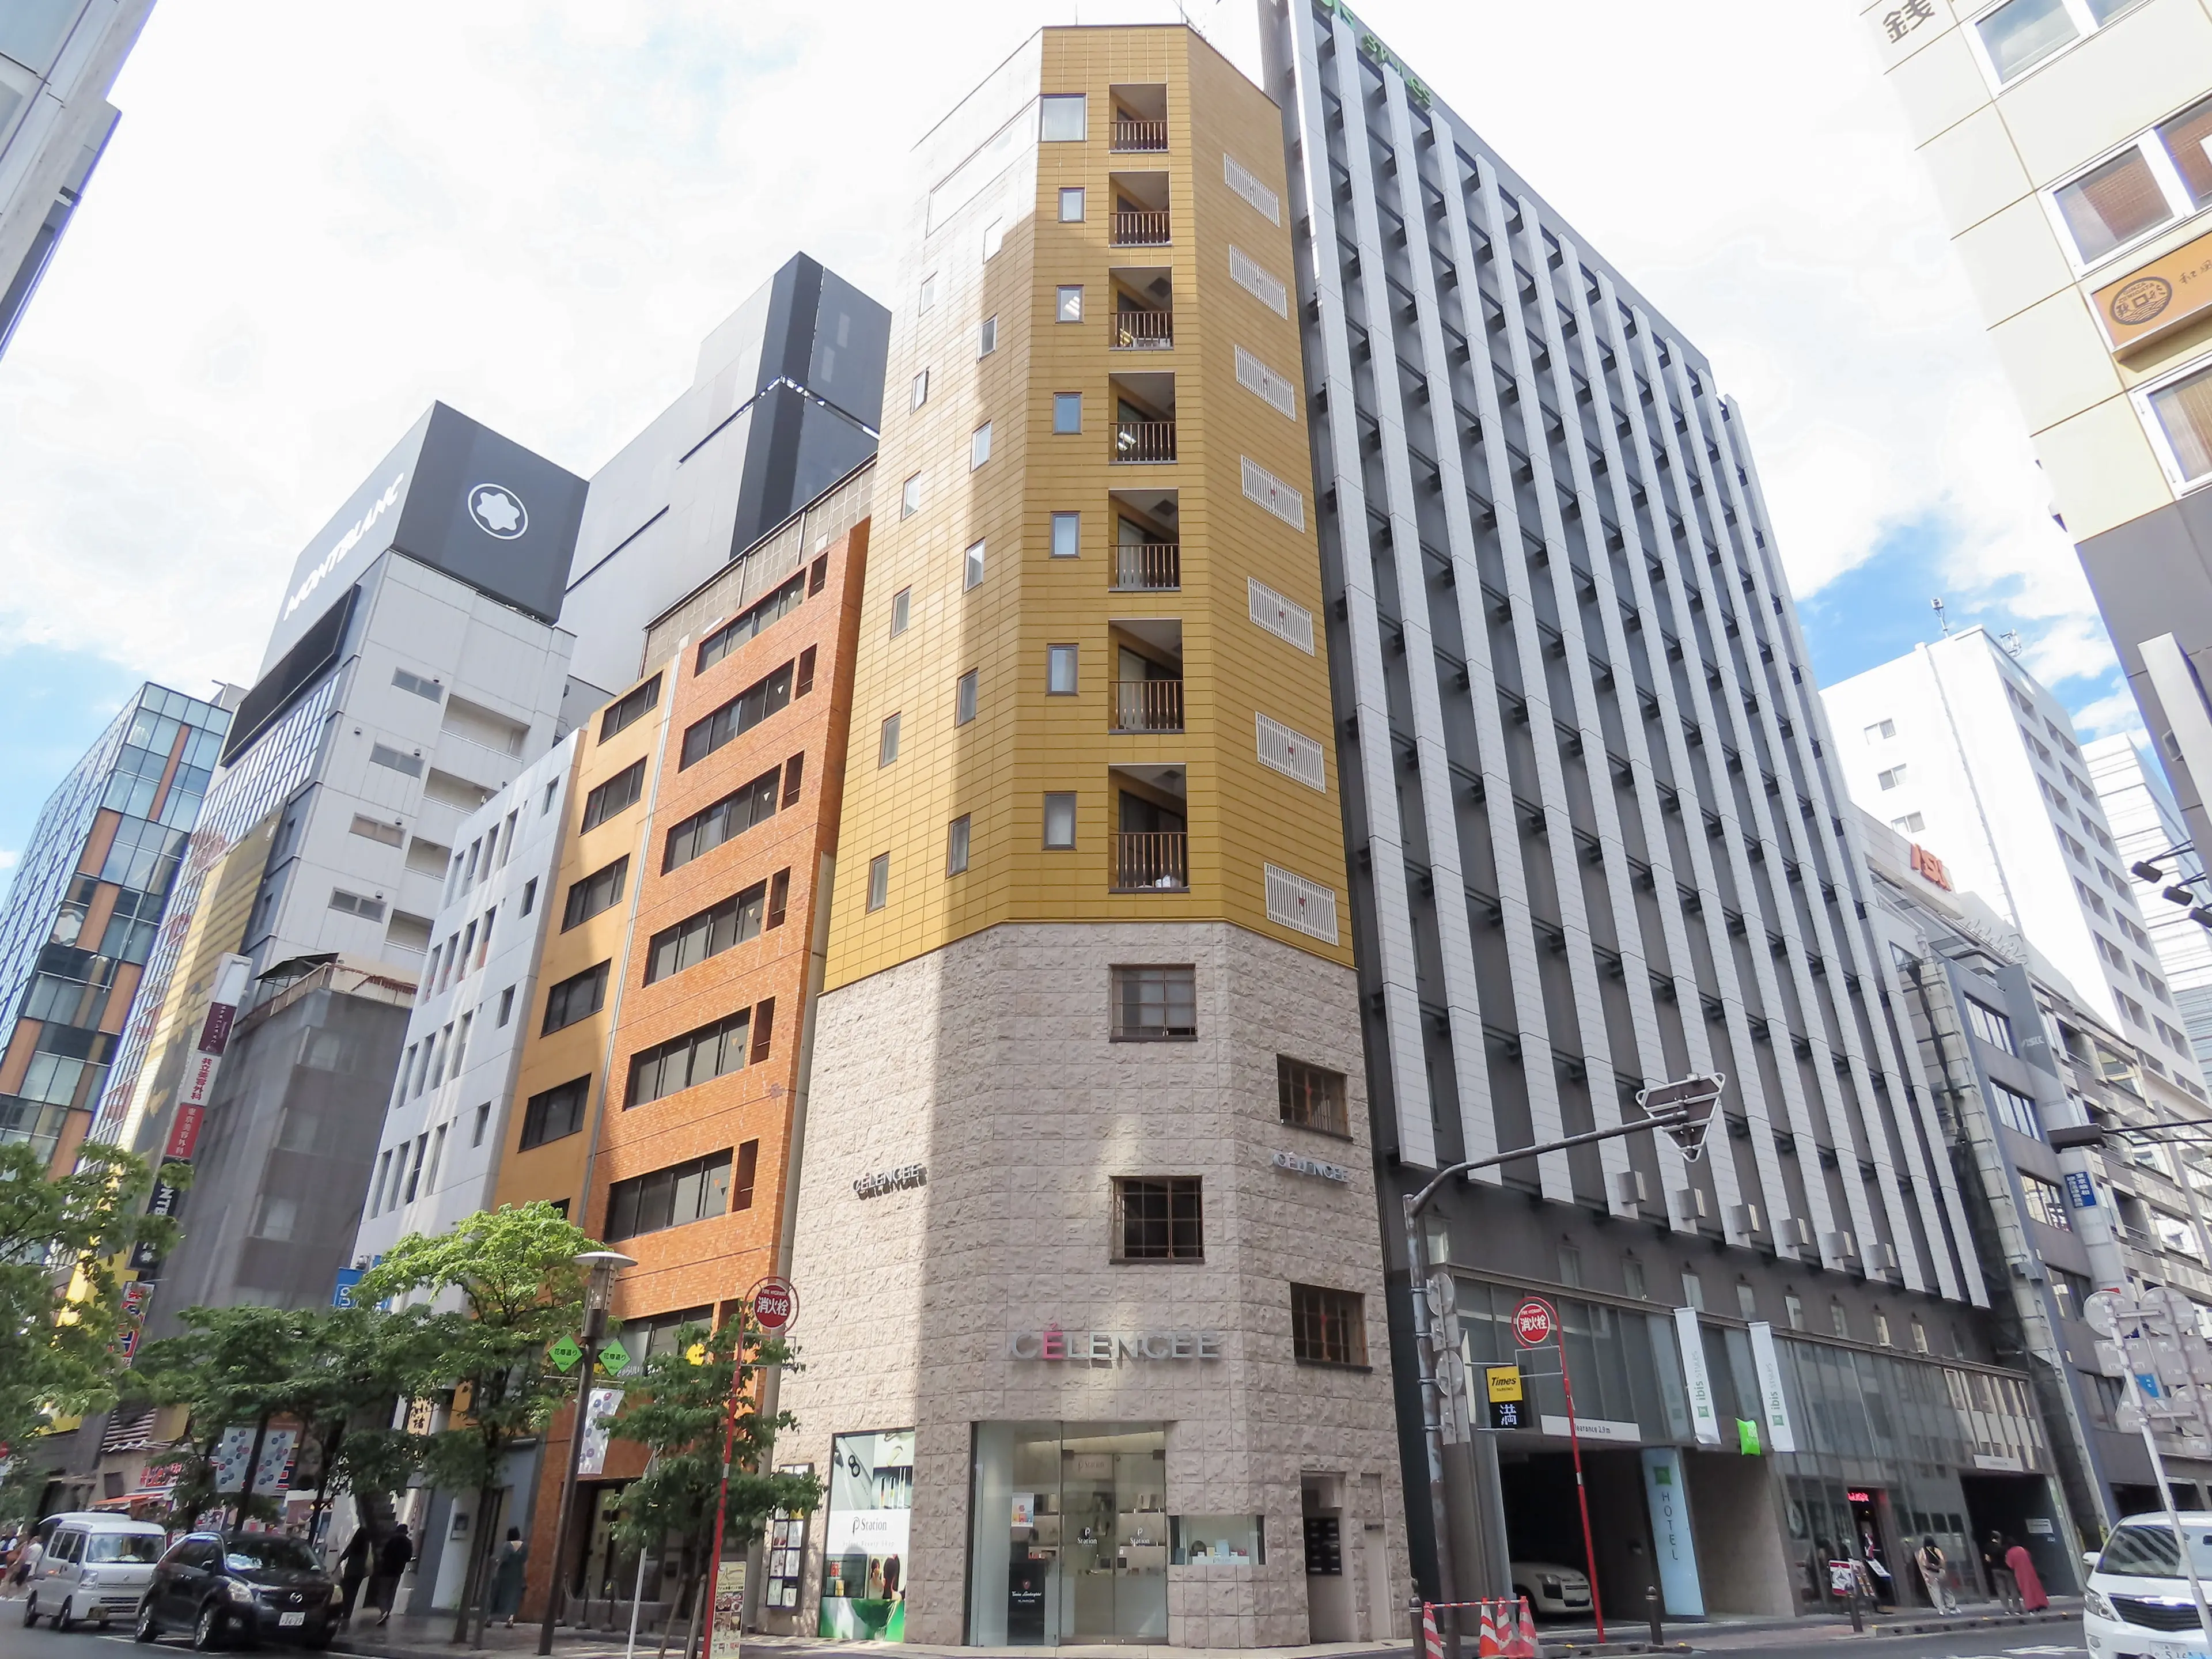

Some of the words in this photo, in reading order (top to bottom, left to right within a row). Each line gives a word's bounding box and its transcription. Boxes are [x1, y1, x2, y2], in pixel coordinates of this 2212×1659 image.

[757, 1297, 789, 1316] 消火栓
[1520, 1315, 1547, 1332] 消火栓
[1011, 1321, 1221, 1360] CÉLENCEE
[1491, 1376, 1517, 1386] Times
[1694, 1381, 1706, 1401] ibis
[1768, 1391, 1781, 1410] ibis
[1499, 1404, 1517, 1426] 満
[1574, 1423, 1598, 1433] learance
[861, 1517, 888, 1532] Station
[1661, 1491, 1679, 1561] HOTEL
[1077, 1536, 1097, 1544] Station
